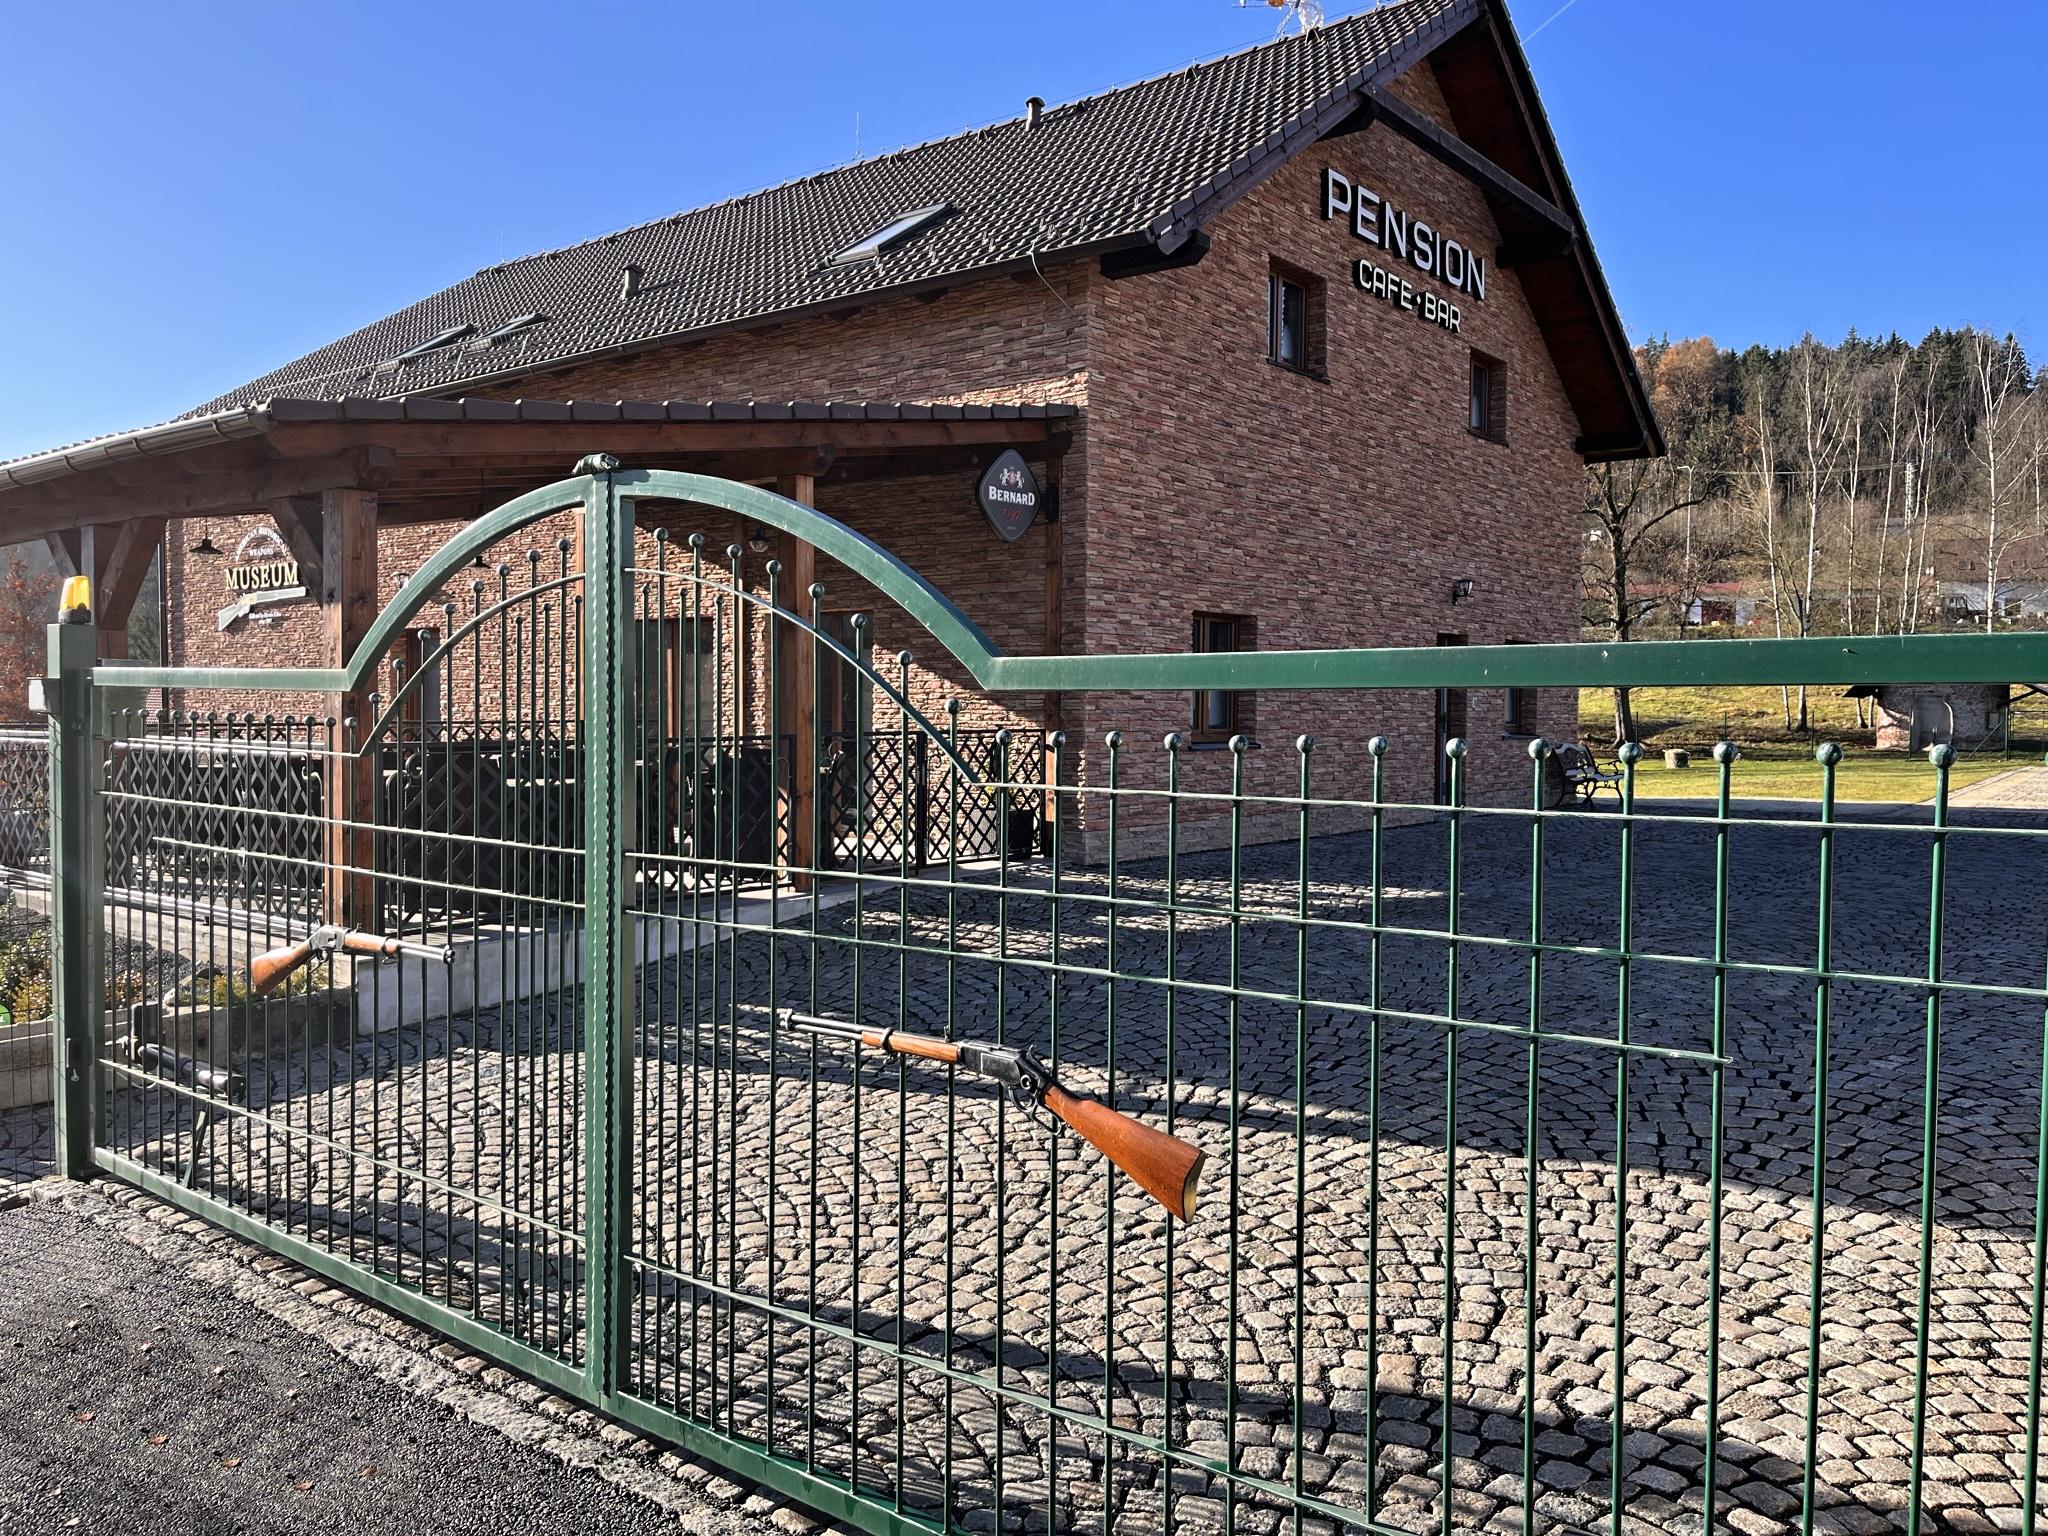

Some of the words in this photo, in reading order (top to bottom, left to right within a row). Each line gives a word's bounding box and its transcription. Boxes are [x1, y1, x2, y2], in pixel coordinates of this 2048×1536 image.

[1328, 168, 1485, 300] PENSION
[1359, 259, 1413, 310] CAFE
[1425, 292, 1461, 333] BAR
[988, 485, 1036, 506] BERNARD
[249, 547, 274, 557] WEAPONS
[224, 561, 299, 590] MUSEUM
